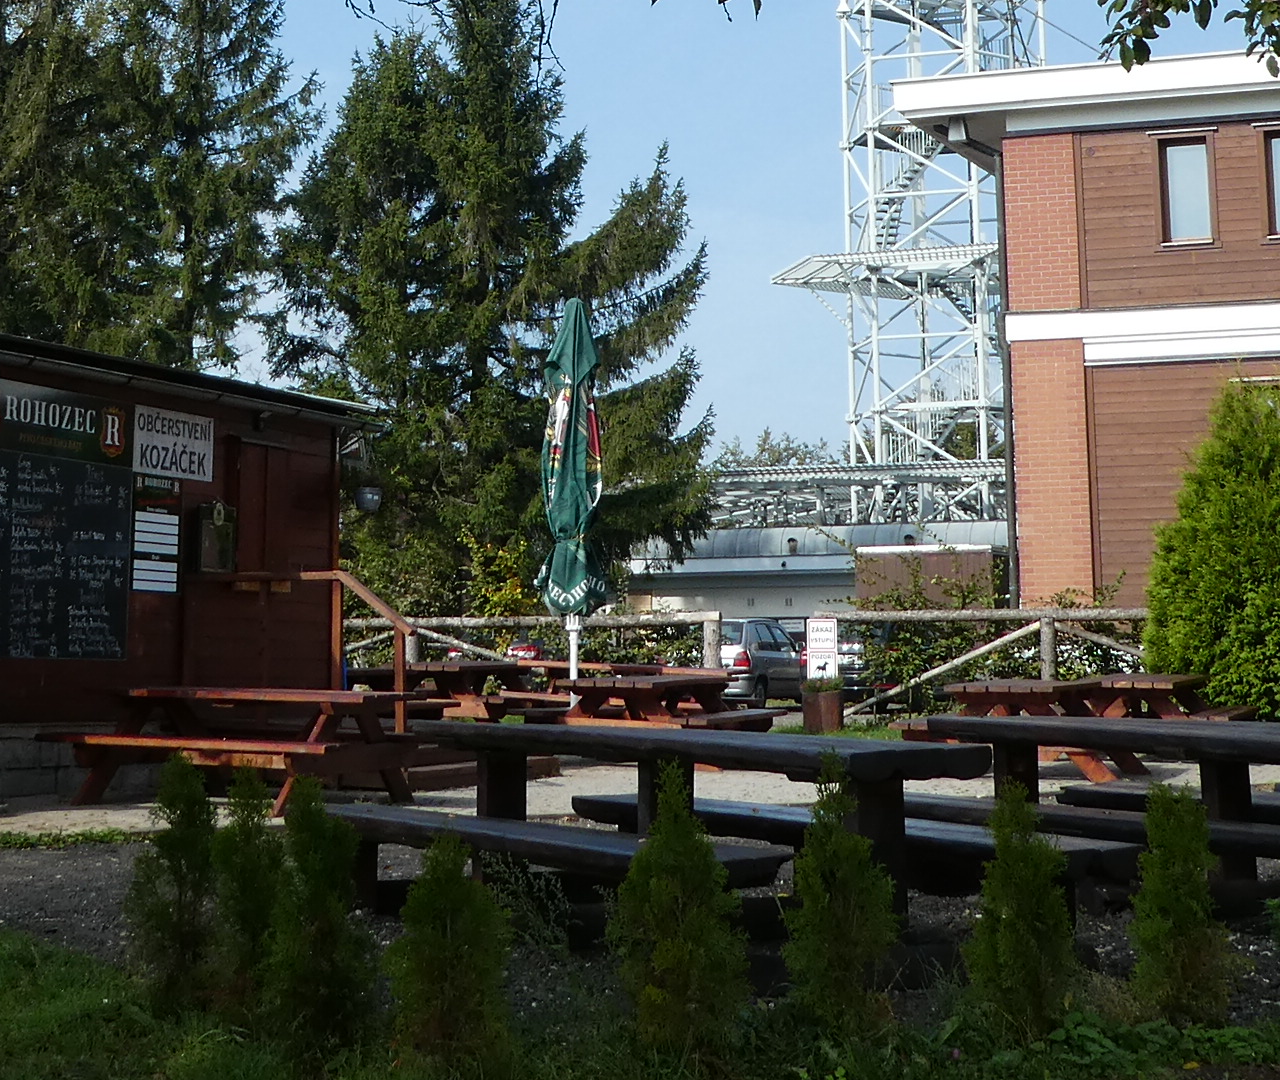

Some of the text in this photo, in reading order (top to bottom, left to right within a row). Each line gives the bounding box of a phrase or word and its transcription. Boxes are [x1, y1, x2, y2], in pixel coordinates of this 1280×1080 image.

[4, 395, 97, 434] ROHOZEC
[105, 414, 120, 446] R
[137, 412, 212, 442] OBČERSTVENÍ
[140, 442, 206, 476] KOZÁČEK
[811, 625, 833, 633] ZÁKAZ
